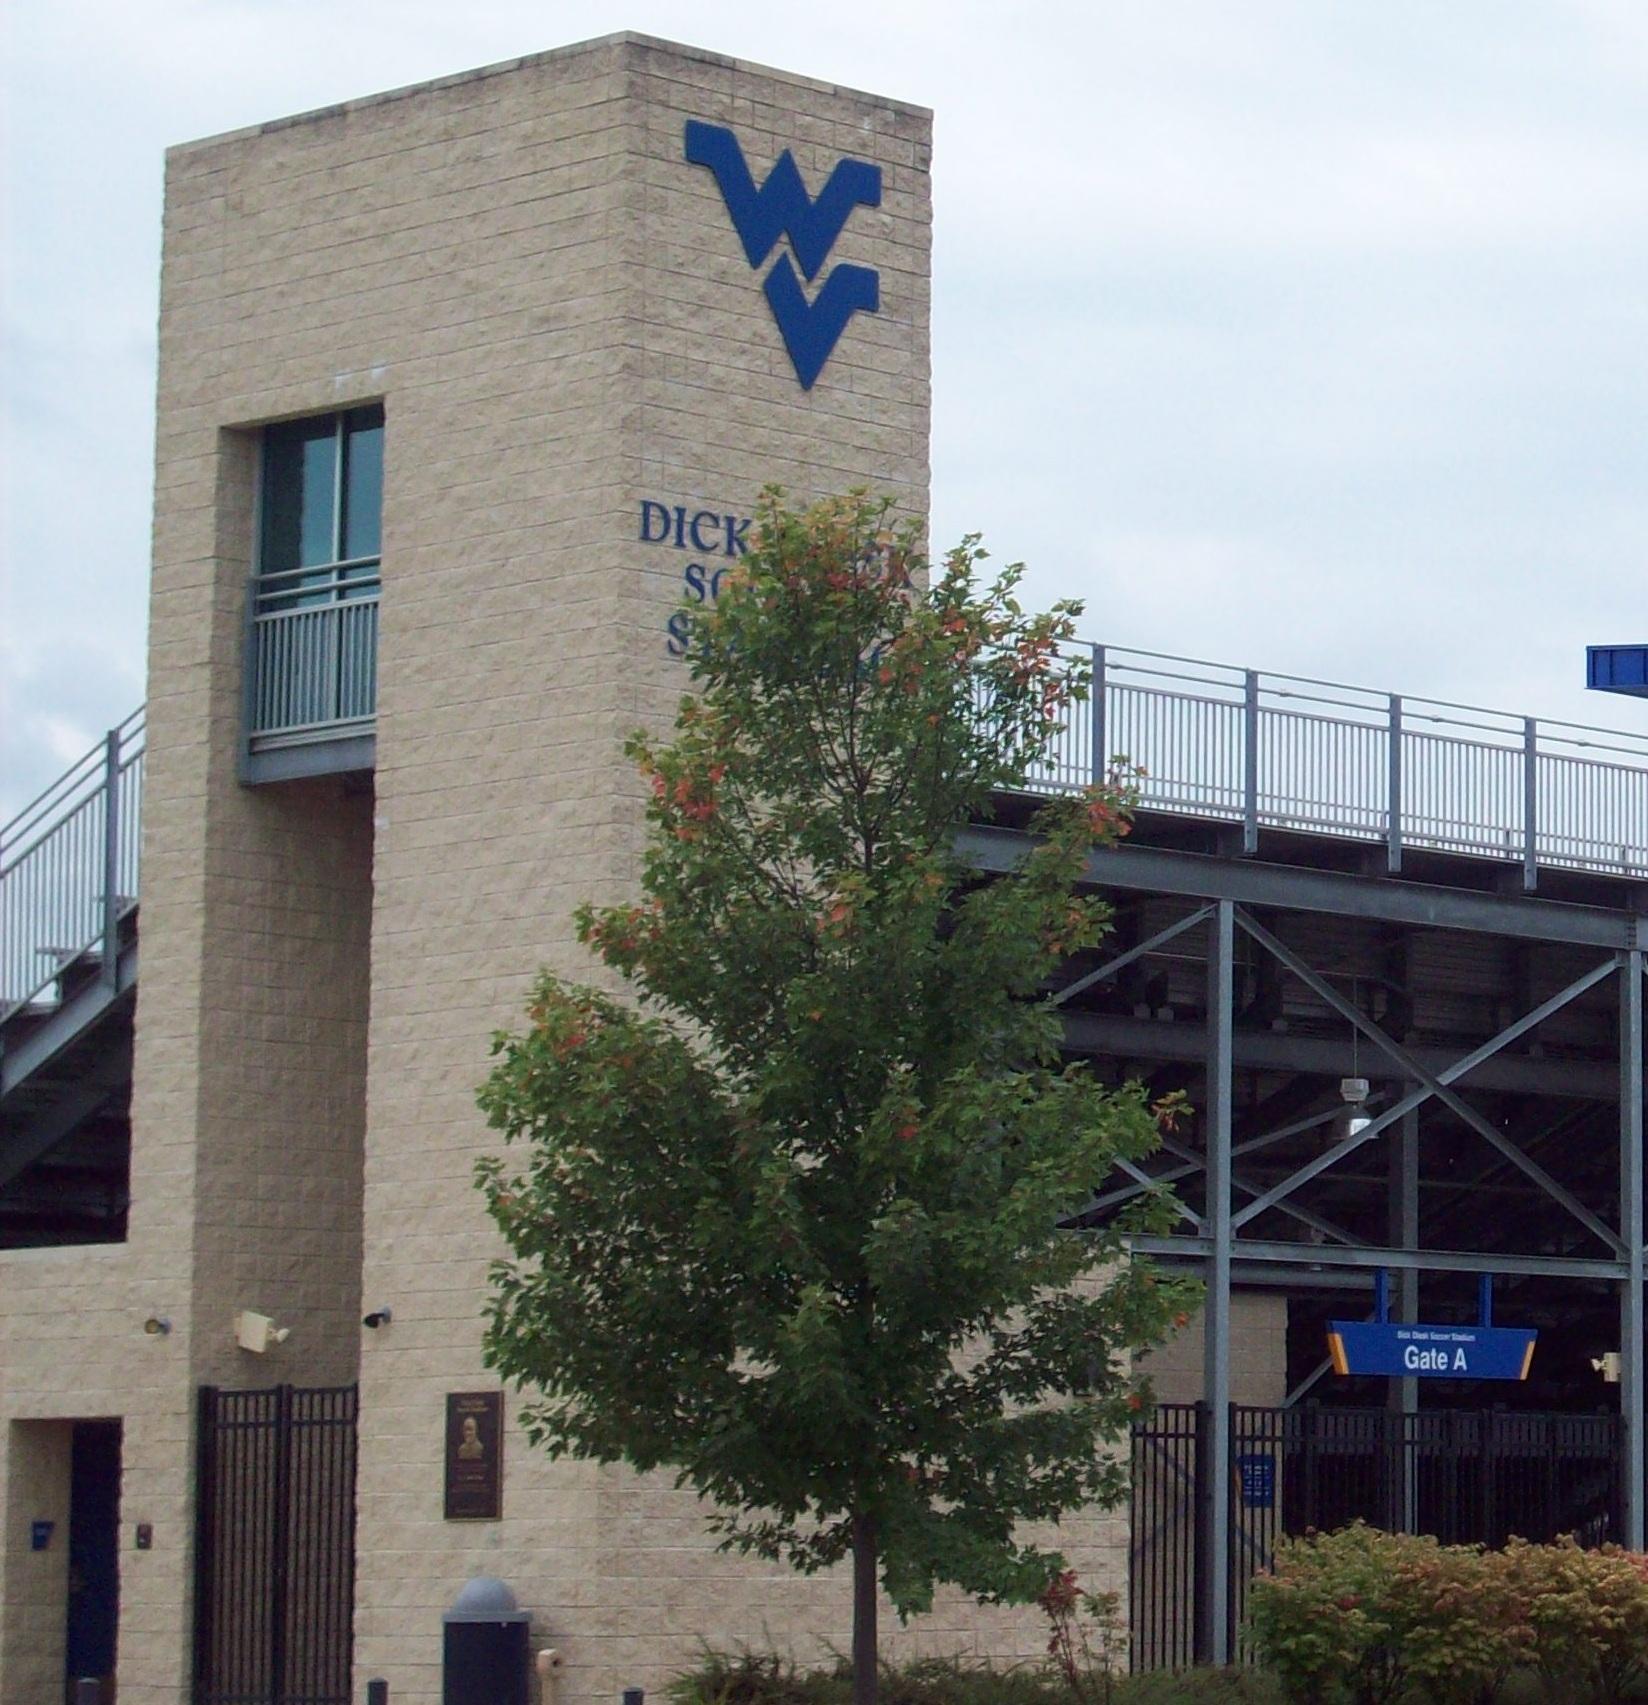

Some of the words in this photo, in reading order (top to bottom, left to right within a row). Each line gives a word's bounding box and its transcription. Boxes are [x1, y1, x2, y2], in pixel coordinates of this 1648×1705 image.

[639, 499, 753, 558] DICK
[1404, 1345, 1449, 1370] Gate
[1452, 1347, 1468, 1371] A
